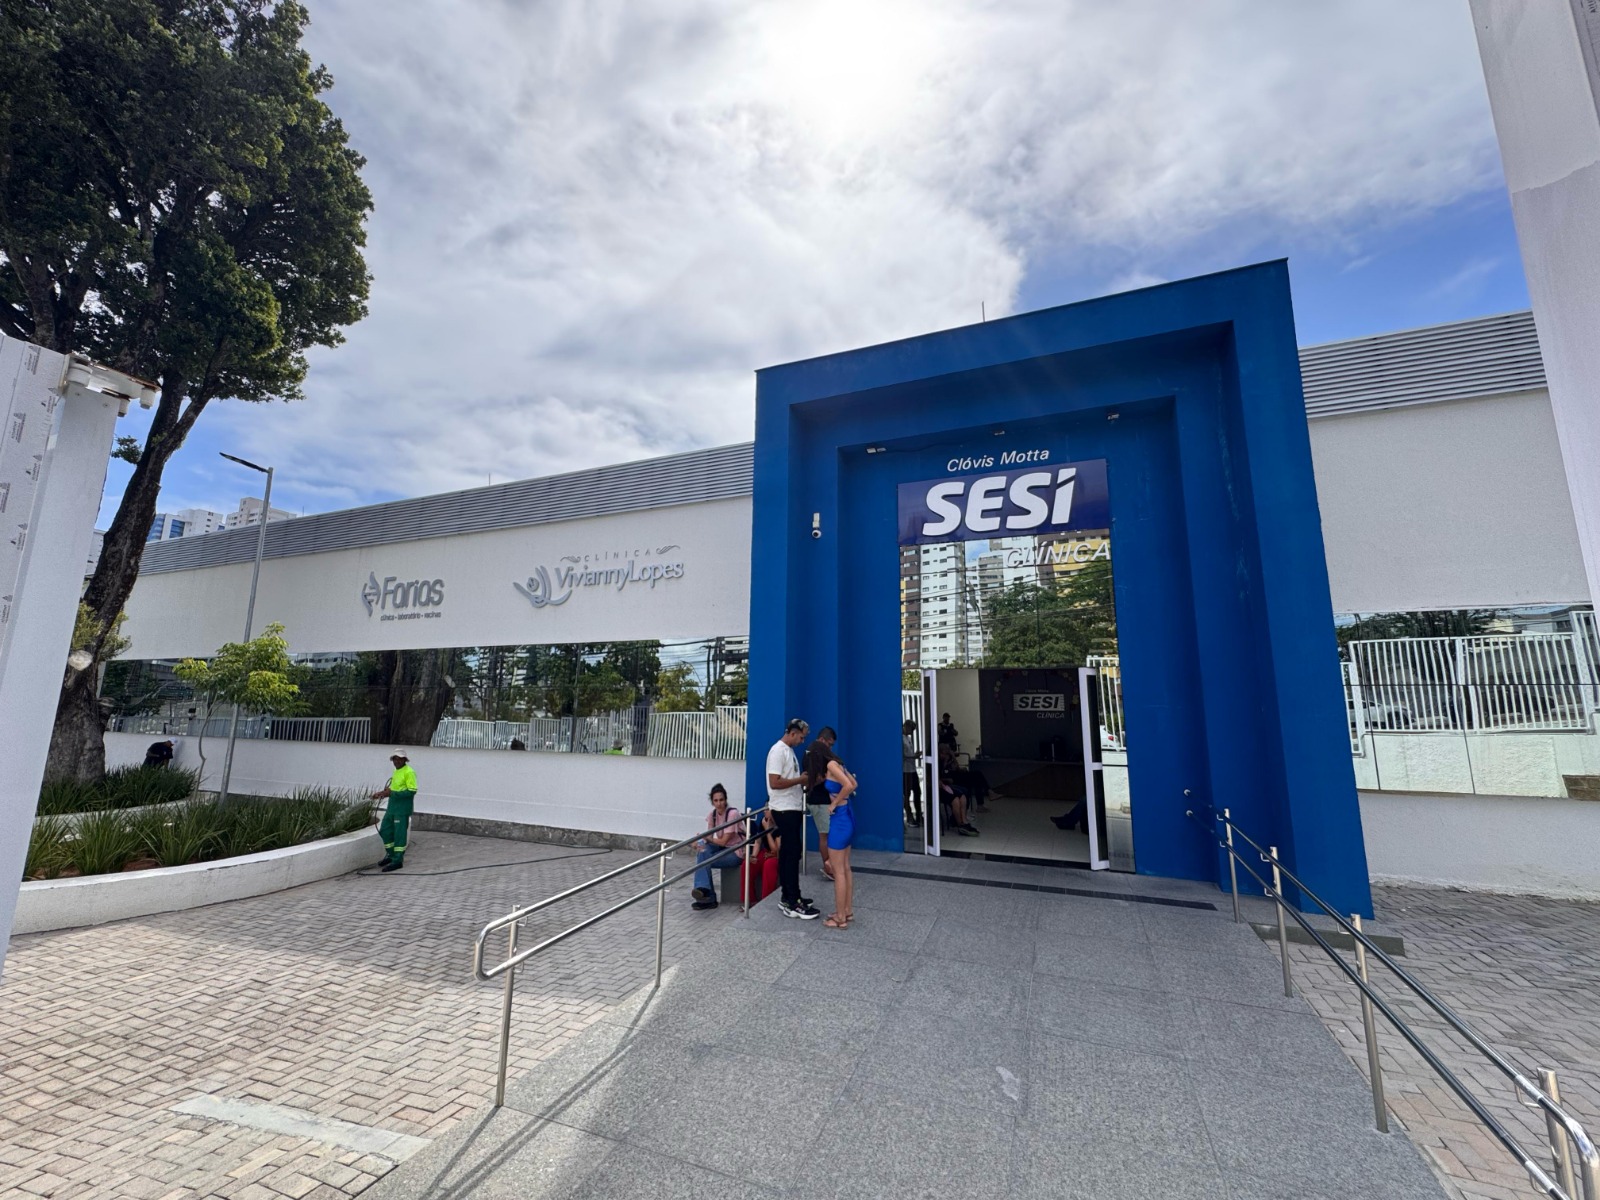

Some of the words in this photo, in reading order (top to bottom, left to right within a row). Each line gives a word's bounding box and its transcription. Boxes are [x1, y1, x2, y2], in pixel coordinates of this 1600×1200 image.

[947, 454, 994, 472] Clóvis
[1000, 449, 1050, 465] Motta
[1006, 540, 1111, 568] CLÍNICA
[381, 576, 445, 610] Farias
[1018, 696, 1059, 709] SESI
